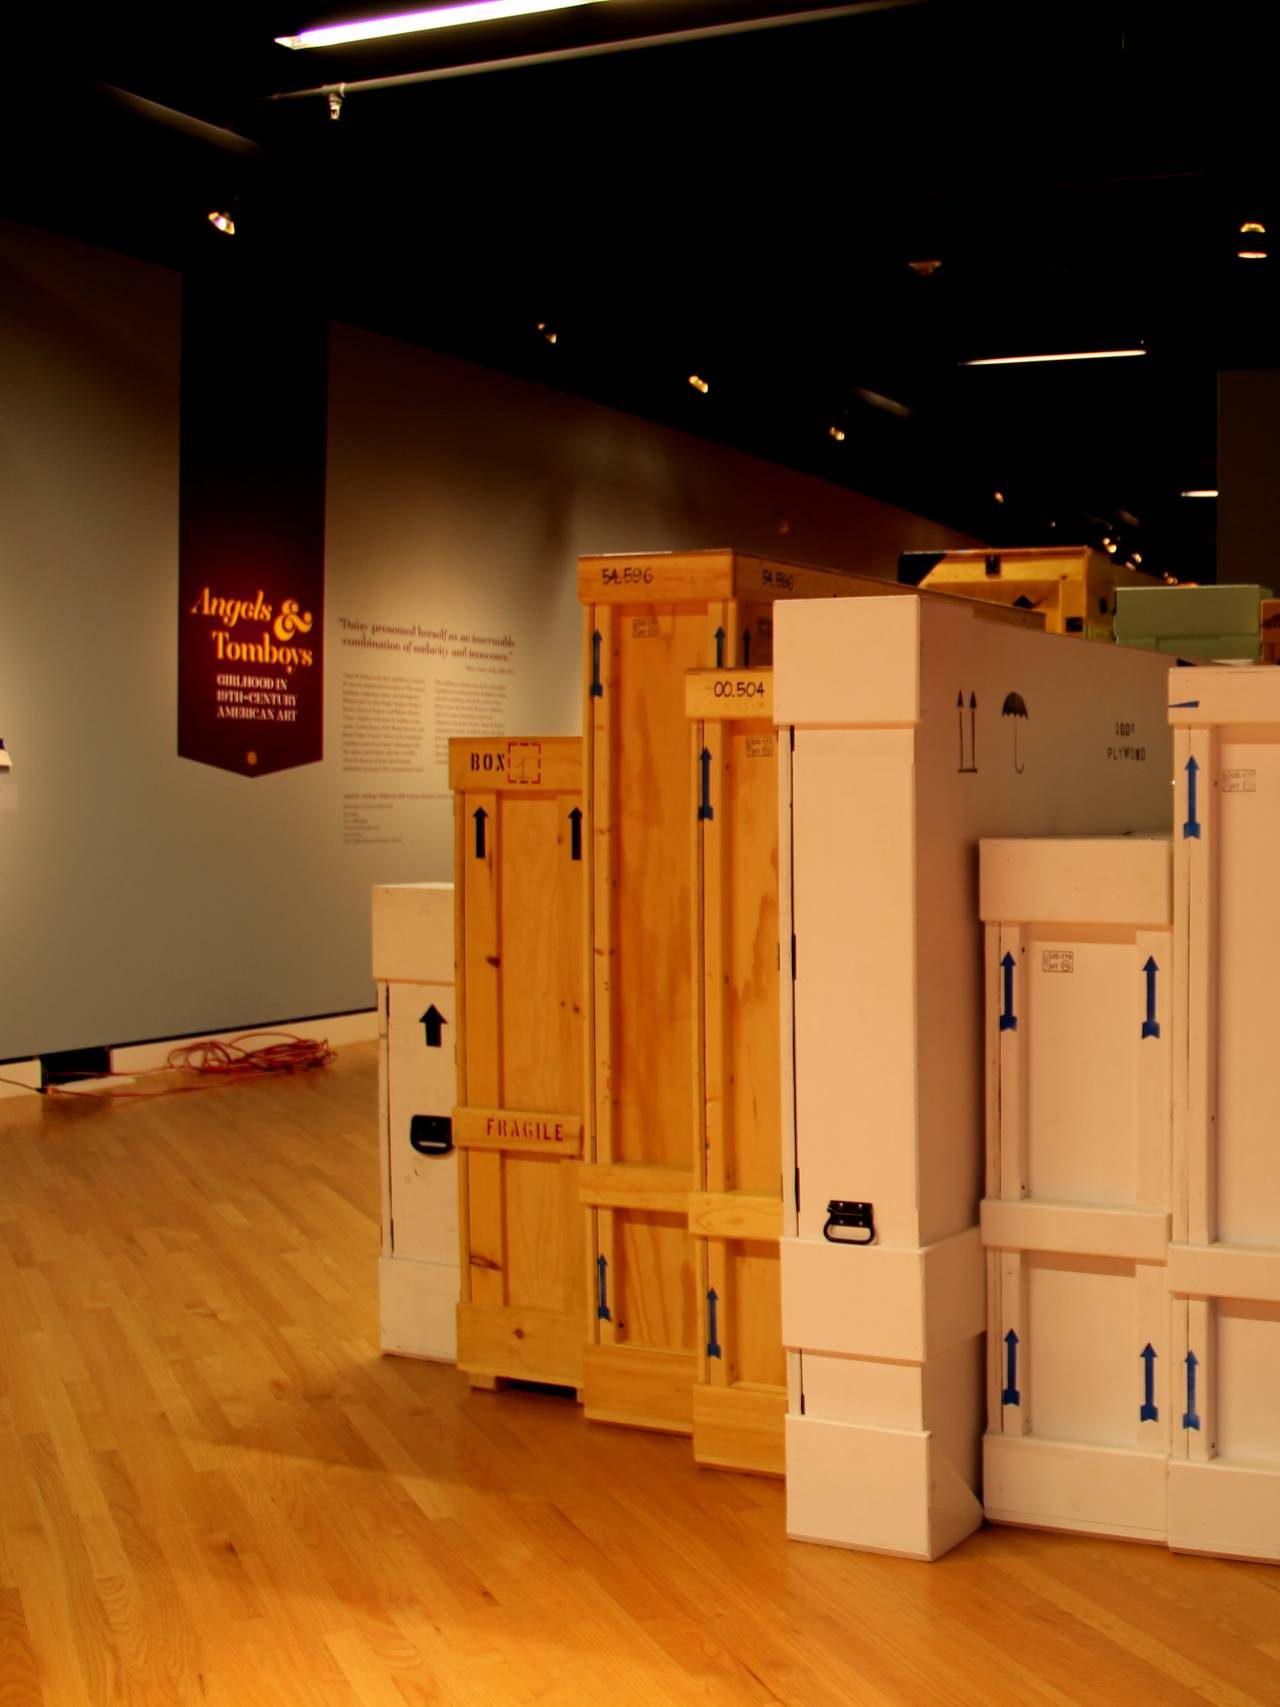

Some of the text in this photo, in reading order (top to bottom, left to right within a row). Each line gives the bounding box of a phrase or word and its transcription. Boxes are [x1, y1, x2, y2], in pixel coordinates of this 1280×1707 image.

[190, 587, 313, 641] Angels &
[211, 631, 313, 674] Tomboys
[216, 674, 288, 691] GIRLHOOD IN
[216, 705, 298, 723] AMERICAN ART
[471, 752, 506, 772] BOX
[486, 1117, 565, 1142] FRAGILE
